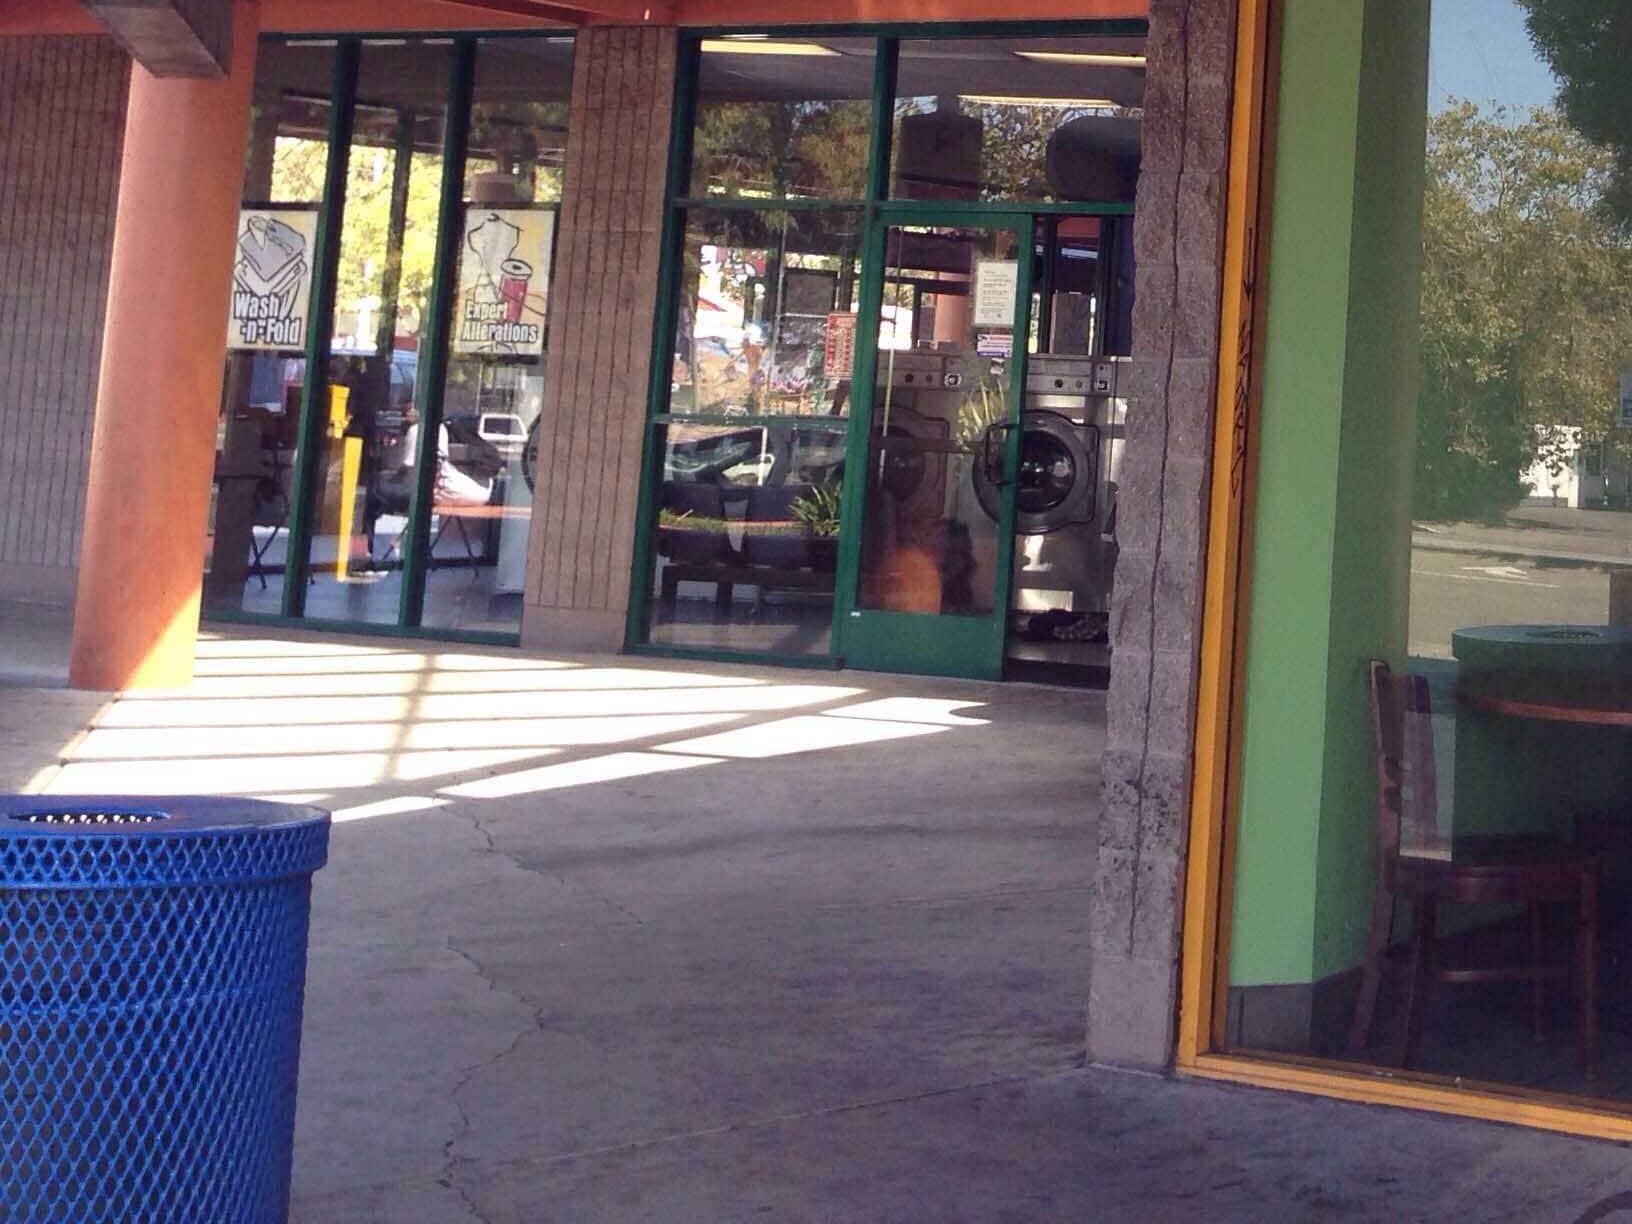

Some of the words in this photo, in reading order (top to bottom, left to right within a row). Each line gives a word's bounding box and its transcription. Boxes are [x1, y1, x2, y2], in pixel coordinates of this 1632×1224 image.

[234, 291, 281, 319] Wash
[465, 299, 509, 321] Expert
[461, 320, 538, 343] Alterations
